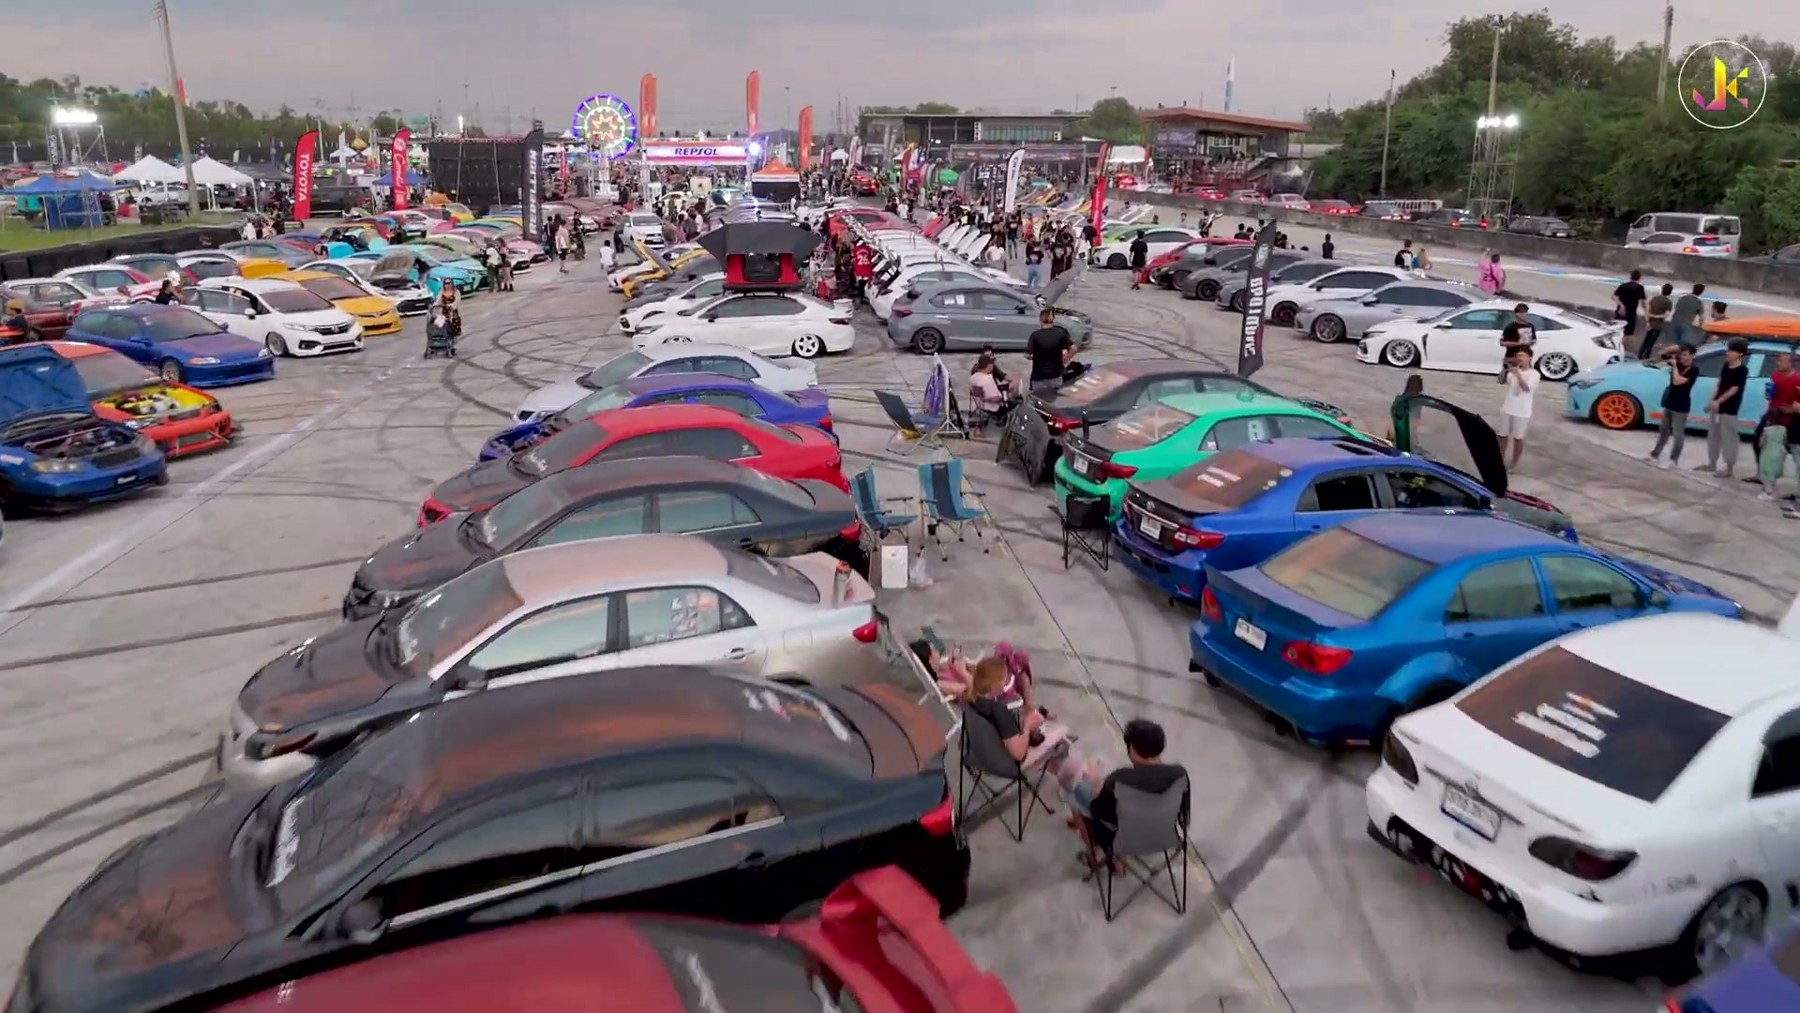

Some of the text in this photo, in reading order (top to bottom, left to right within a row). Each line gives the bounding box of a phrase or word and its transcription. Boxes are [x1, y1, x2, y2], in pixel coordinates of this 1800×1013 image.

[674, 147, 720, 156] REPSOL
[299, 153, 310, 201] TOYOTA
[529, 149, 538, 235] REBELLION
